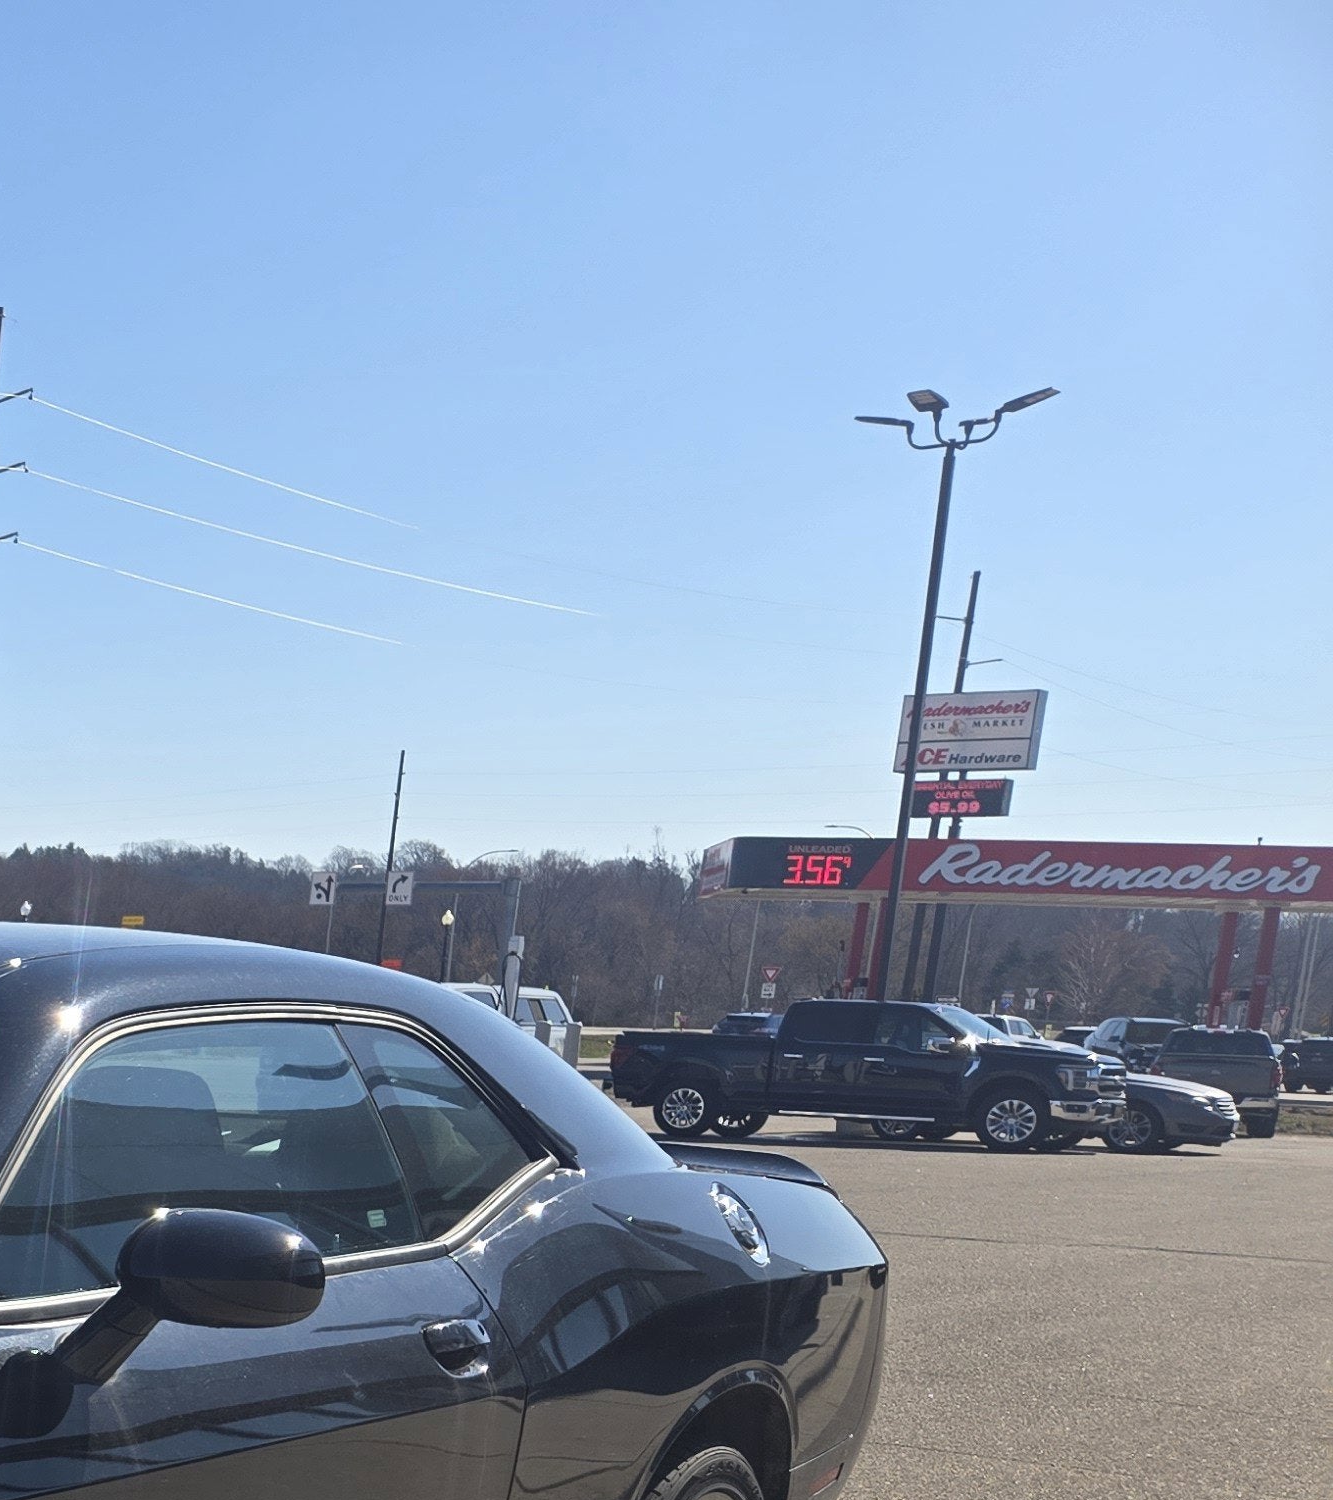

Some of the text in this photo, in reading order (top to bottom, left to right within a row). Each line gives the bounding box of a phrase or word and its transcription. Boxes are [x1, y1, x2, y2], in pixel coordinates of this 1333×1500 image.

[907, 699, 1032, 718] adermacher's
[971, 718, 1025, 728] MARKET
[900, 747, 1022, 766] CE Hardware
[788, 844, 852, 854] UNLEADED
[918, 842, 1322, 894] Radermacher's
[388, 894, 410, 903] ONLY
